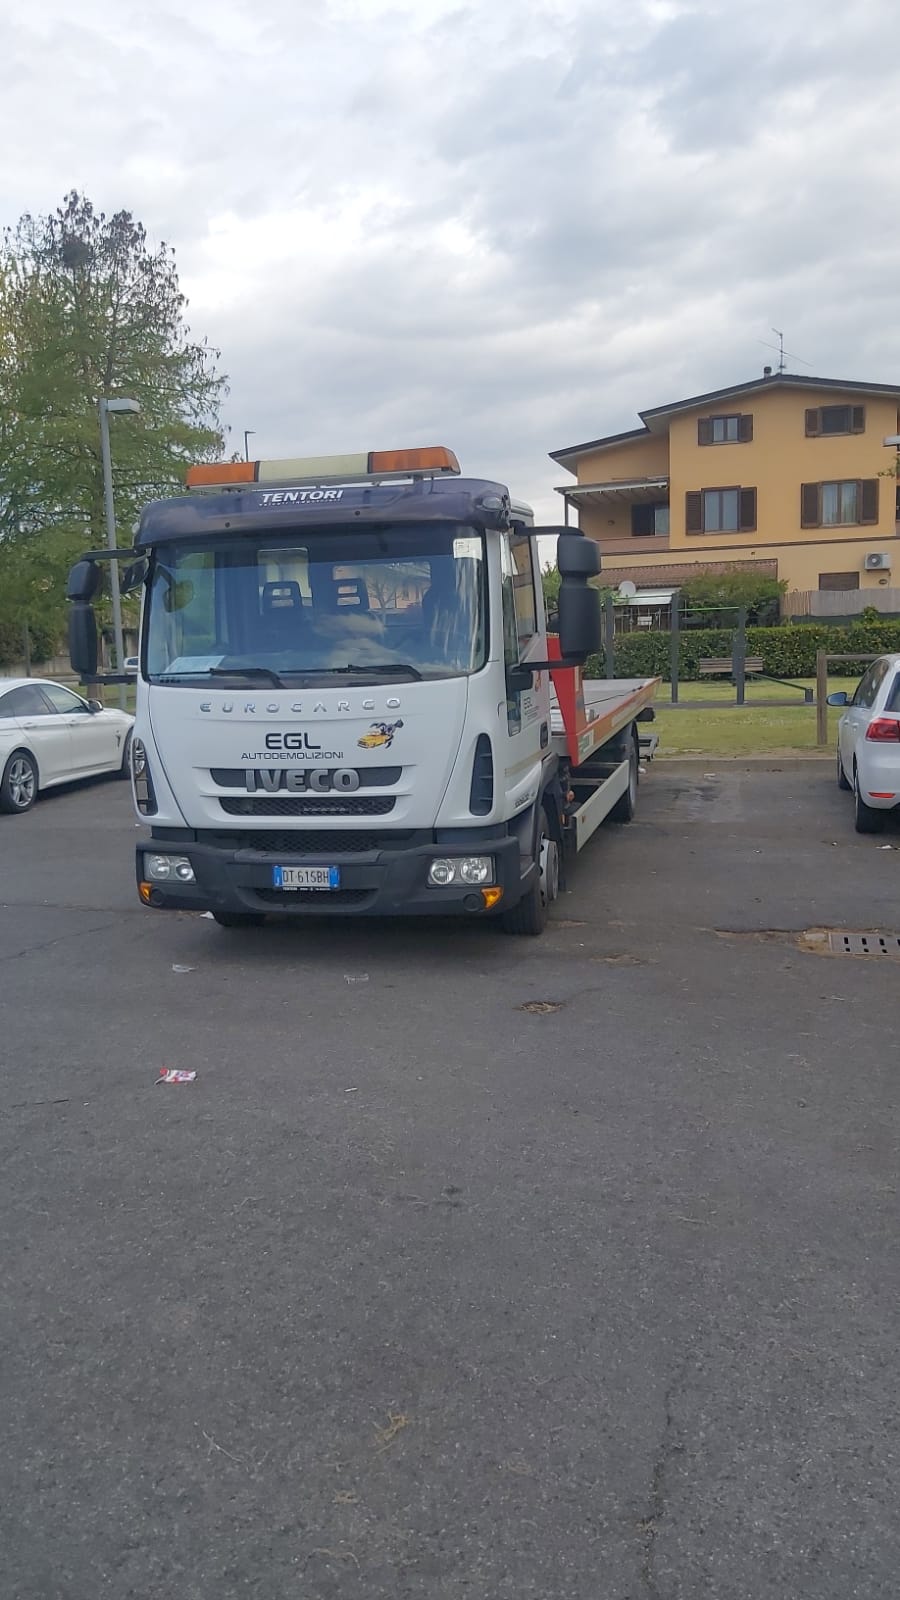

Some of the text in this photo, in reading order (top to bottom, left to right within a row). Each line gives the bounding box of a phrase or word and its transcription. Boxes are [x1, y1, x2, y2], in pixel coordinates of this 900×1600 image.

[262, 489, 344, 503] TENTORI
[200, 698, 401, 714] EUROCARGO
[265, 732, 321, 750] EGL
[241, 751, 344, 760] AUTODEMOLIZIONI
[245, 768, 360, 793] IVECO
